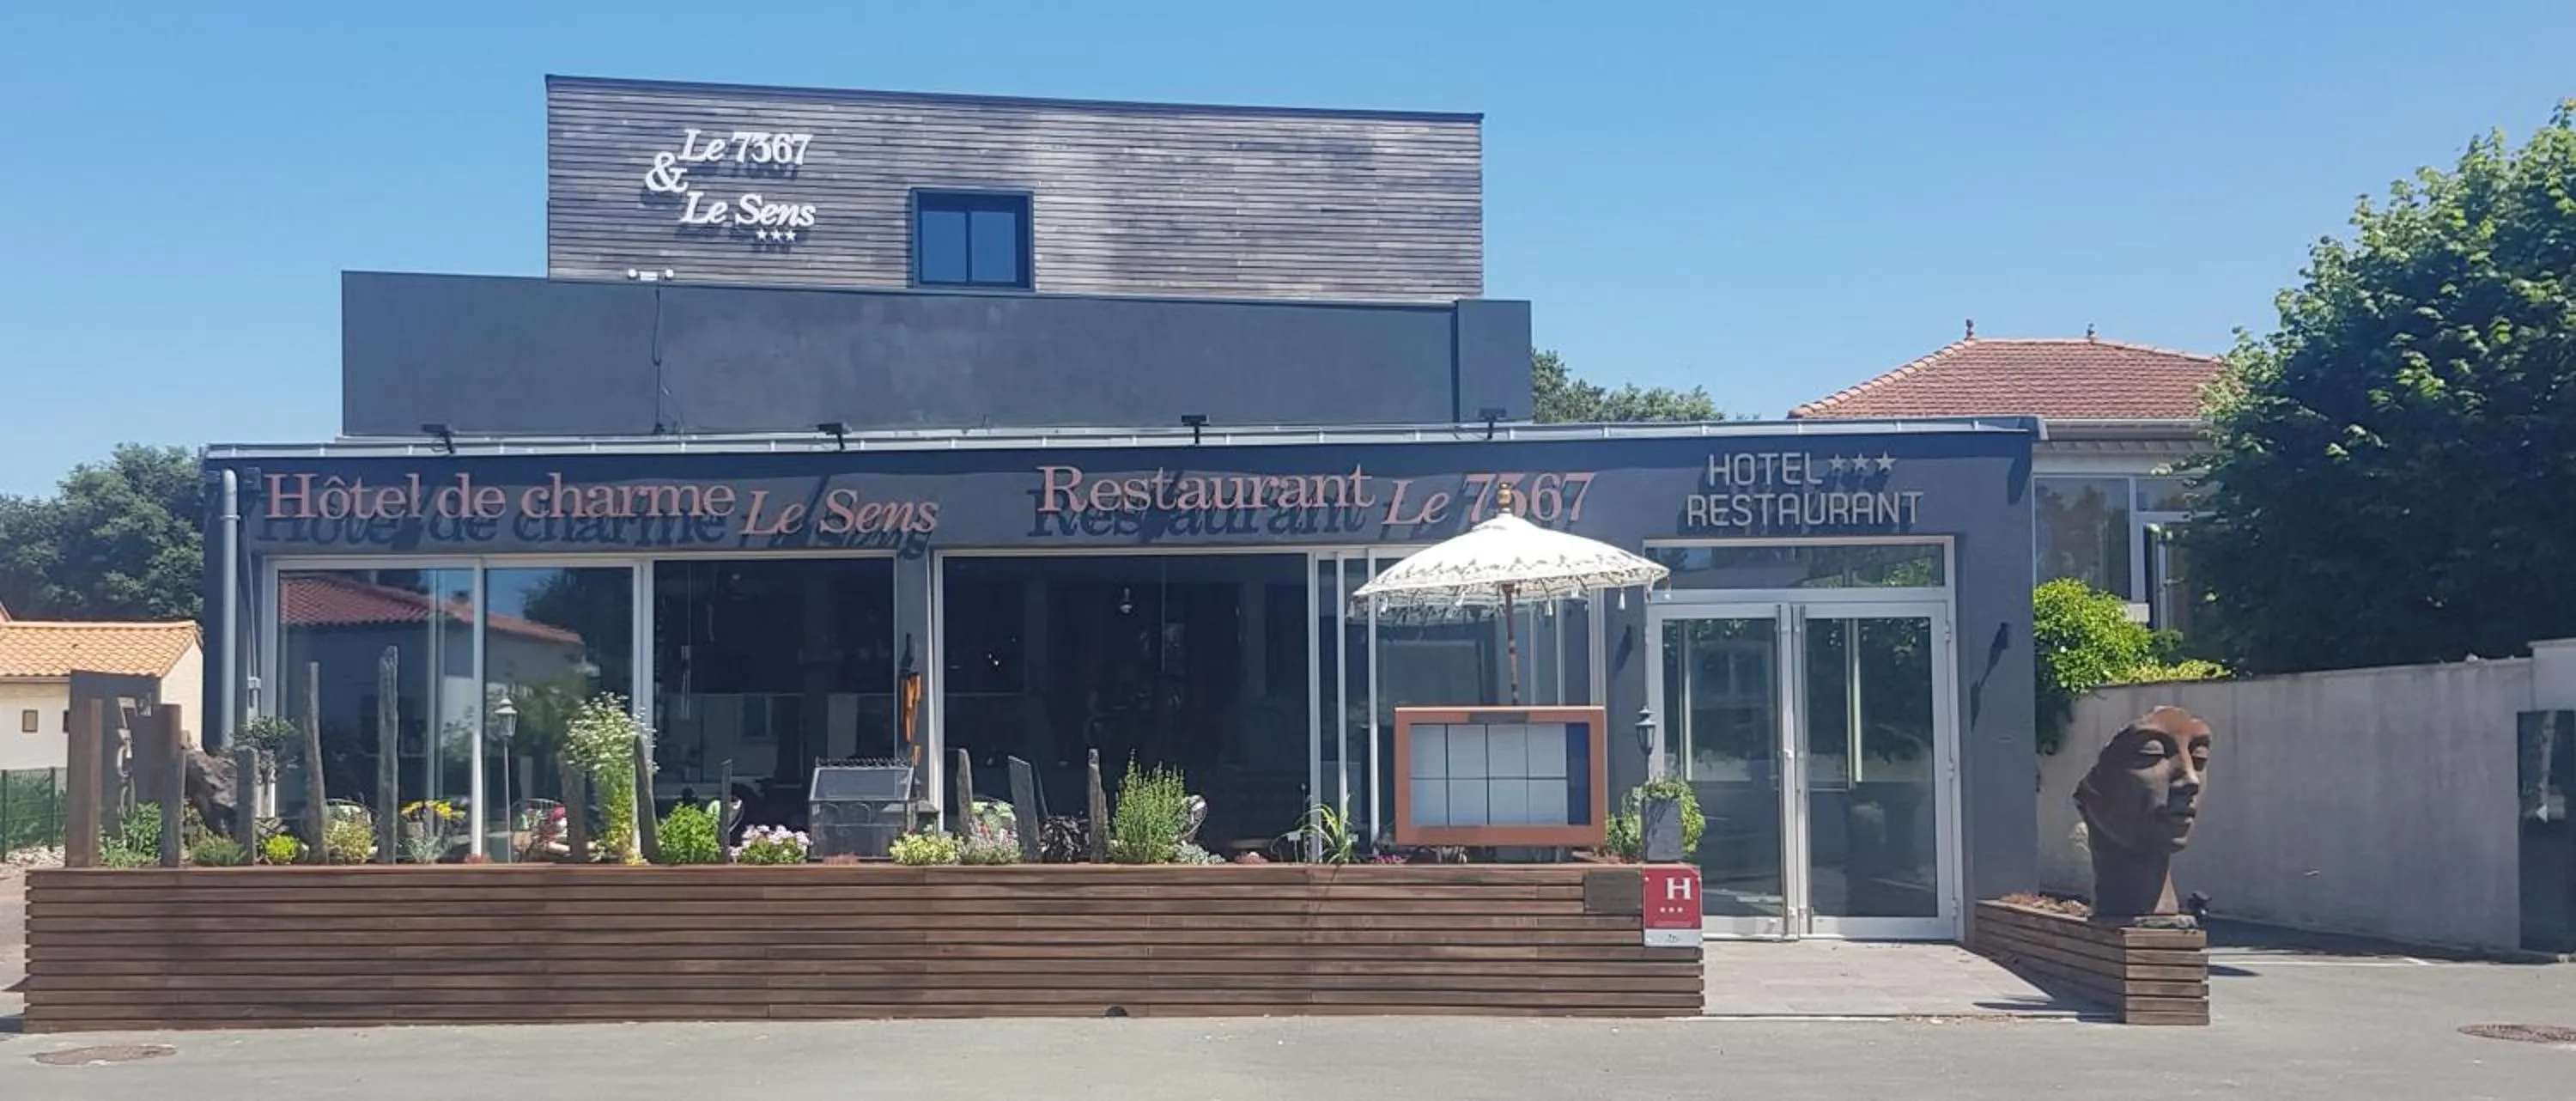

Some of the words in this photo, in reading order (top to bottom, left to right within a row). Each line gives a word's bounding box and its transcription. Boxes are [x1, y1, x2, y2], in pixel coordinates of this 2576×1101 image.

[678, 129, 726, 162] Le
[731, 131, 814, 165] 7367
[645, 151, 689, 192] &
[679, 192, 728, 224] Le
[735, 193, 816, 227] Sens
[1036, 462, 1377, 513] Restaurant
[1708, 452, 1823, 486] HOTEL
[264, 471, 421, 520] Hôtel
[437, 471, 507, 519] de
[520, 471, 737, 519] charme
[739, 489, 808, 537] Le
[819, 488, 941, 535] Sens
[1381, 479, 1451, 525] Le
[1686, 490, 1924, 526] RESTAURANT
[1666, 877, 1692, 900] H
